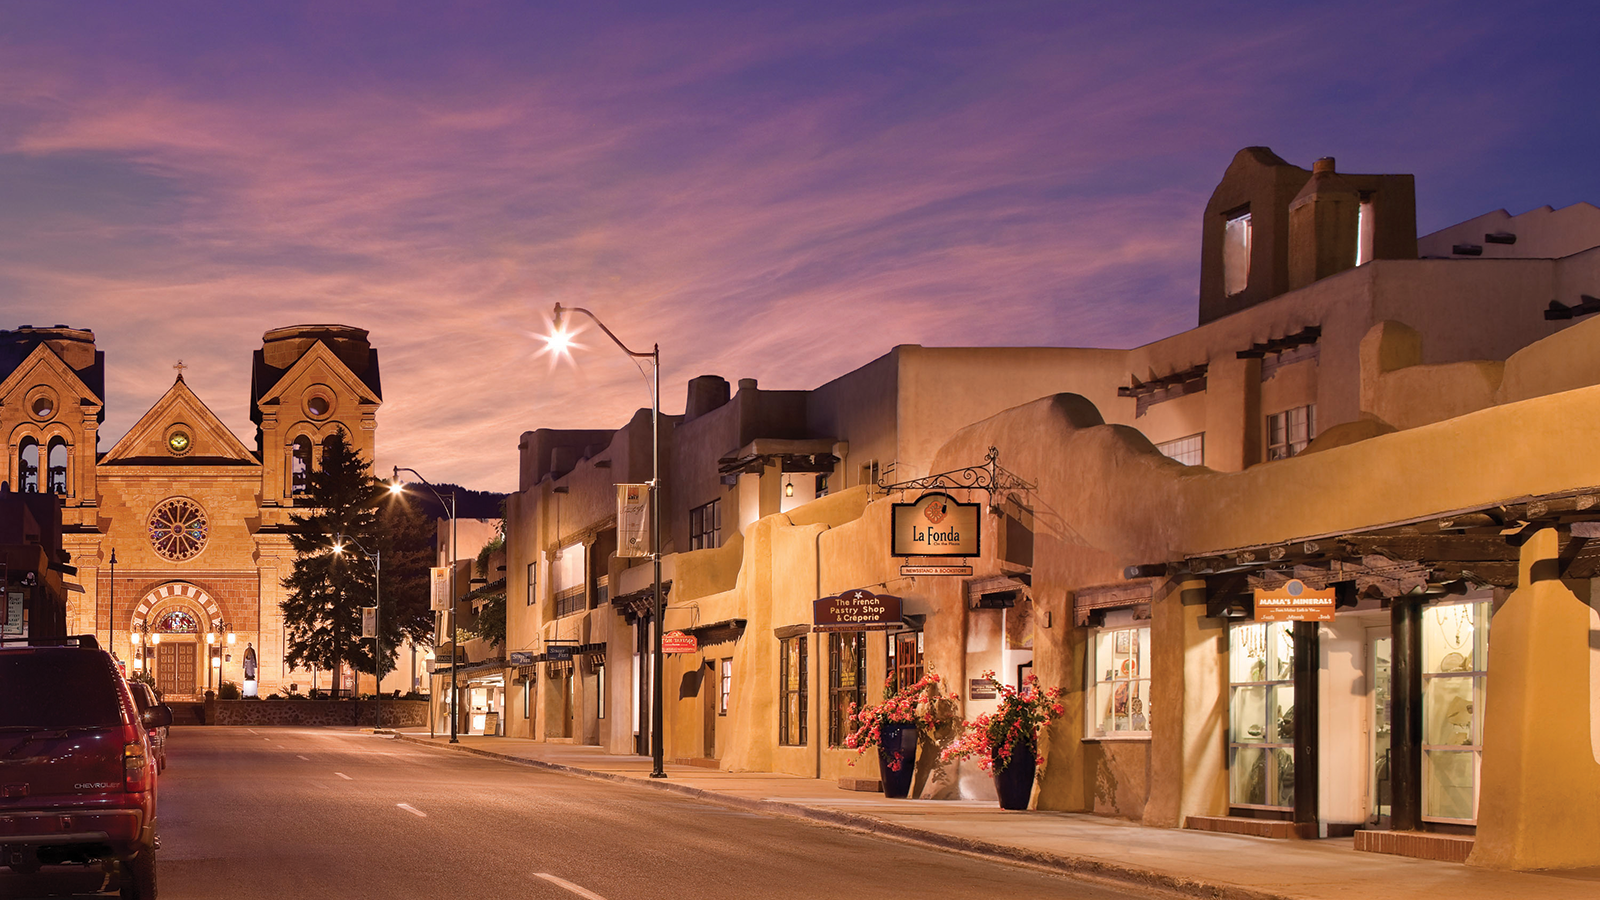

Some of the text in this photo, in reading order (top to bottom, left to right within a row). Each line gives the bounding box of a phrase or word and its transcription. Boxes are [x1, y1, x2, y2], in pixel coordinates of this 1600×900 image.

[913, 525, 960, 546] La Fonda
[852, 598, 880, 606] French
[830, 606, 885, 614] Pastry Shop
